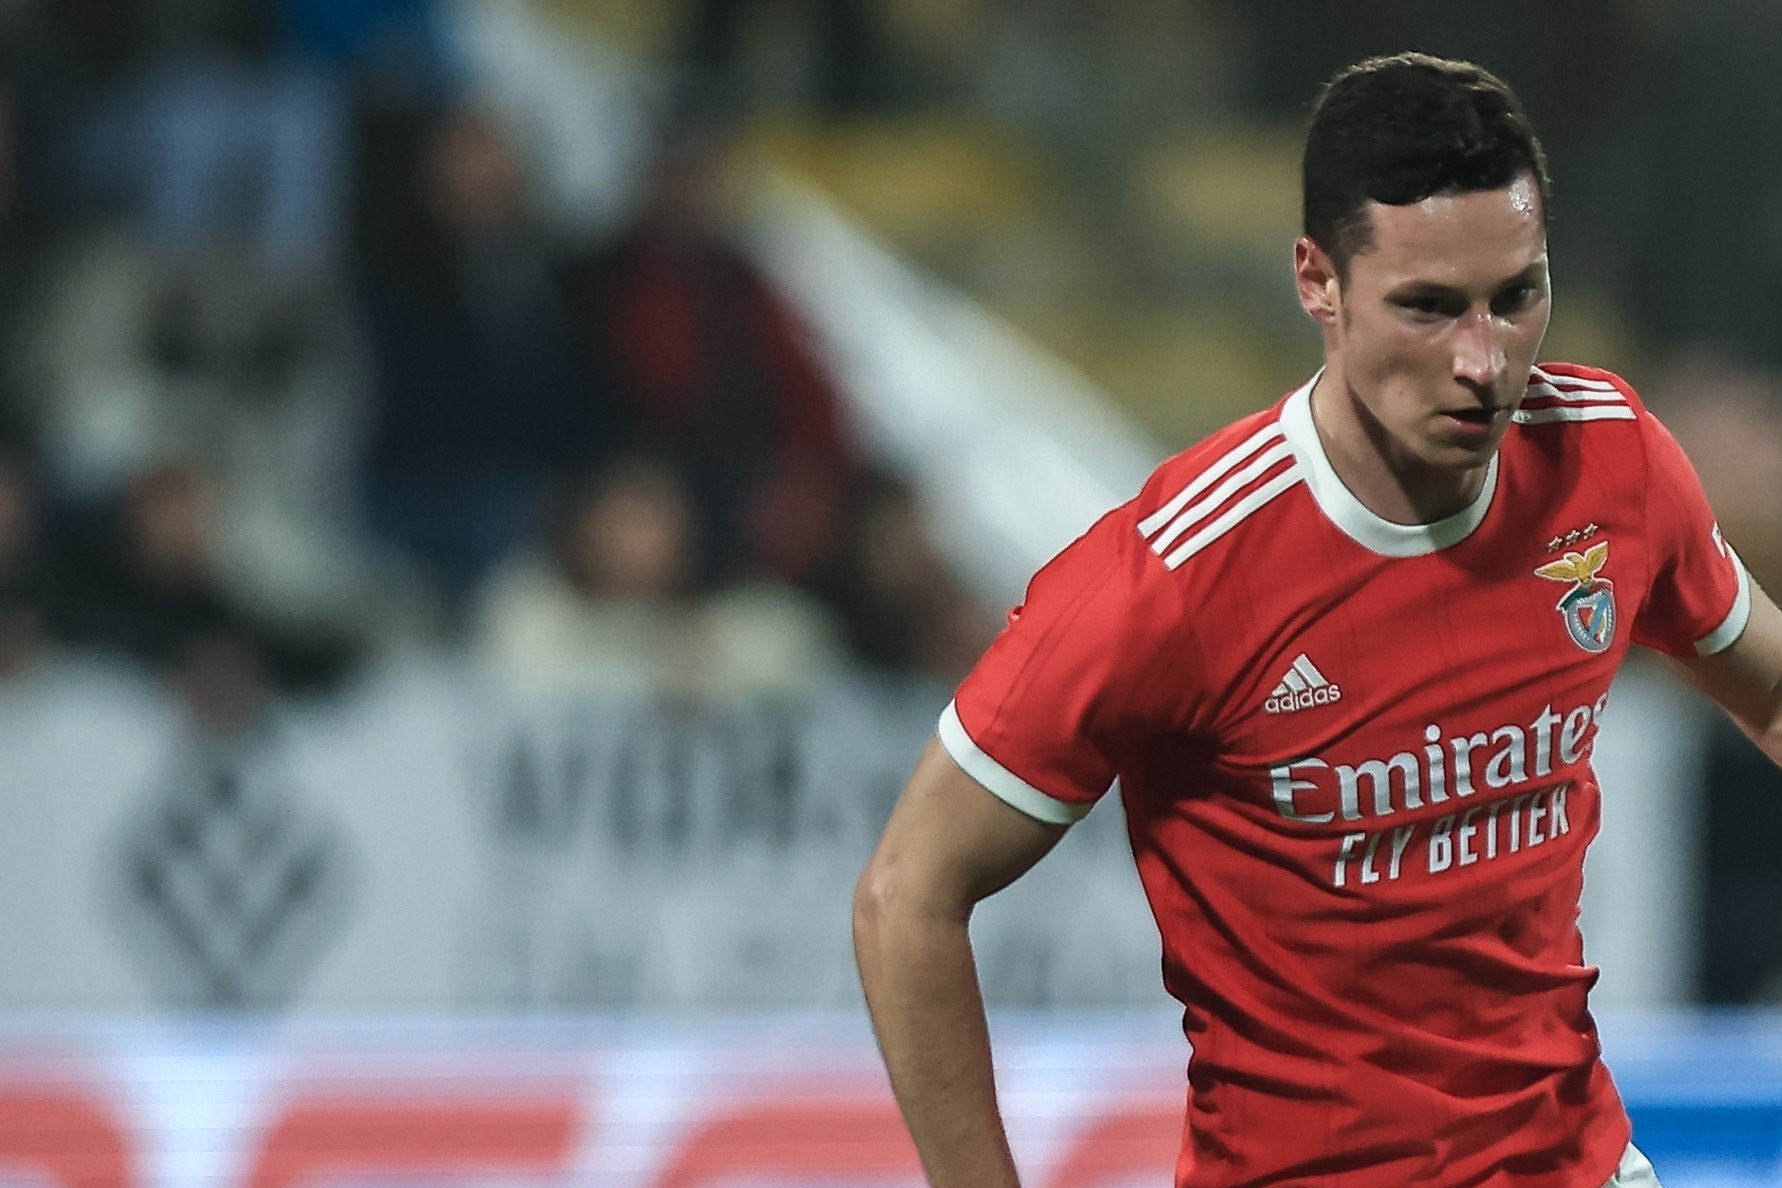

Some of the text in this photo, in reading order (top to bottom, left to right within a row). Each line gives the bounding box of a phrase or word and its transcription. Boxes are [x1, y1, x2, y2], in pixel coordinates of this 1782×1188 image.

[1265, 683, 1342, 714] adidas
[1333, 784, 1571, 888] FLY BETTER
